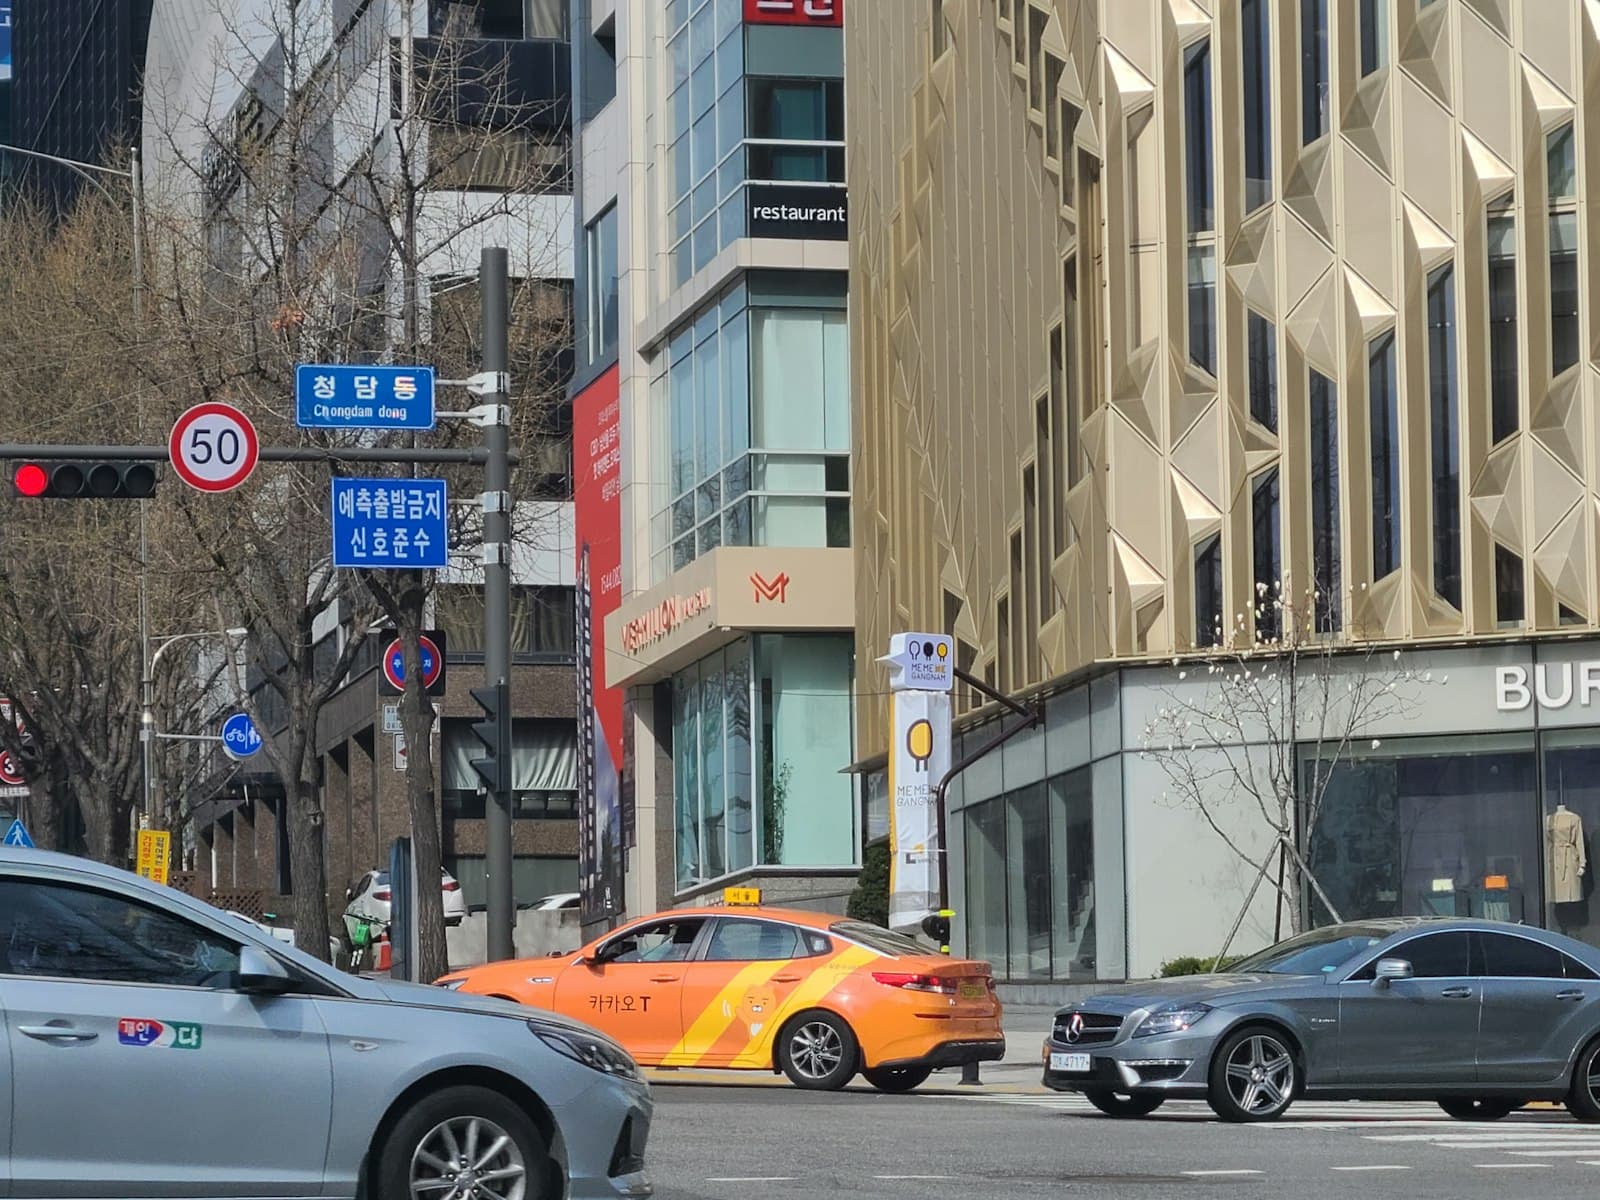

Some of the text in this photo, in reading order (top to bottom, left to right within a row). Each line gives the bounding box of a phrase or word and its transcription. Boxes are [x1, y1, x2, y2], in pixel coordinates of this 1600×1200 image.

[753, 204, 845, 222] restaurant
[313, 375, 418, 401] 청담동
[314, 404, 407, 421] Chongdam dong
[190, 428, 240, 465] 50
[338, 487, 441, 521] 예측출발금지
[350, 526, 431, 559] 신호준수
[120, 1020, 198, 1046] 개인 다
